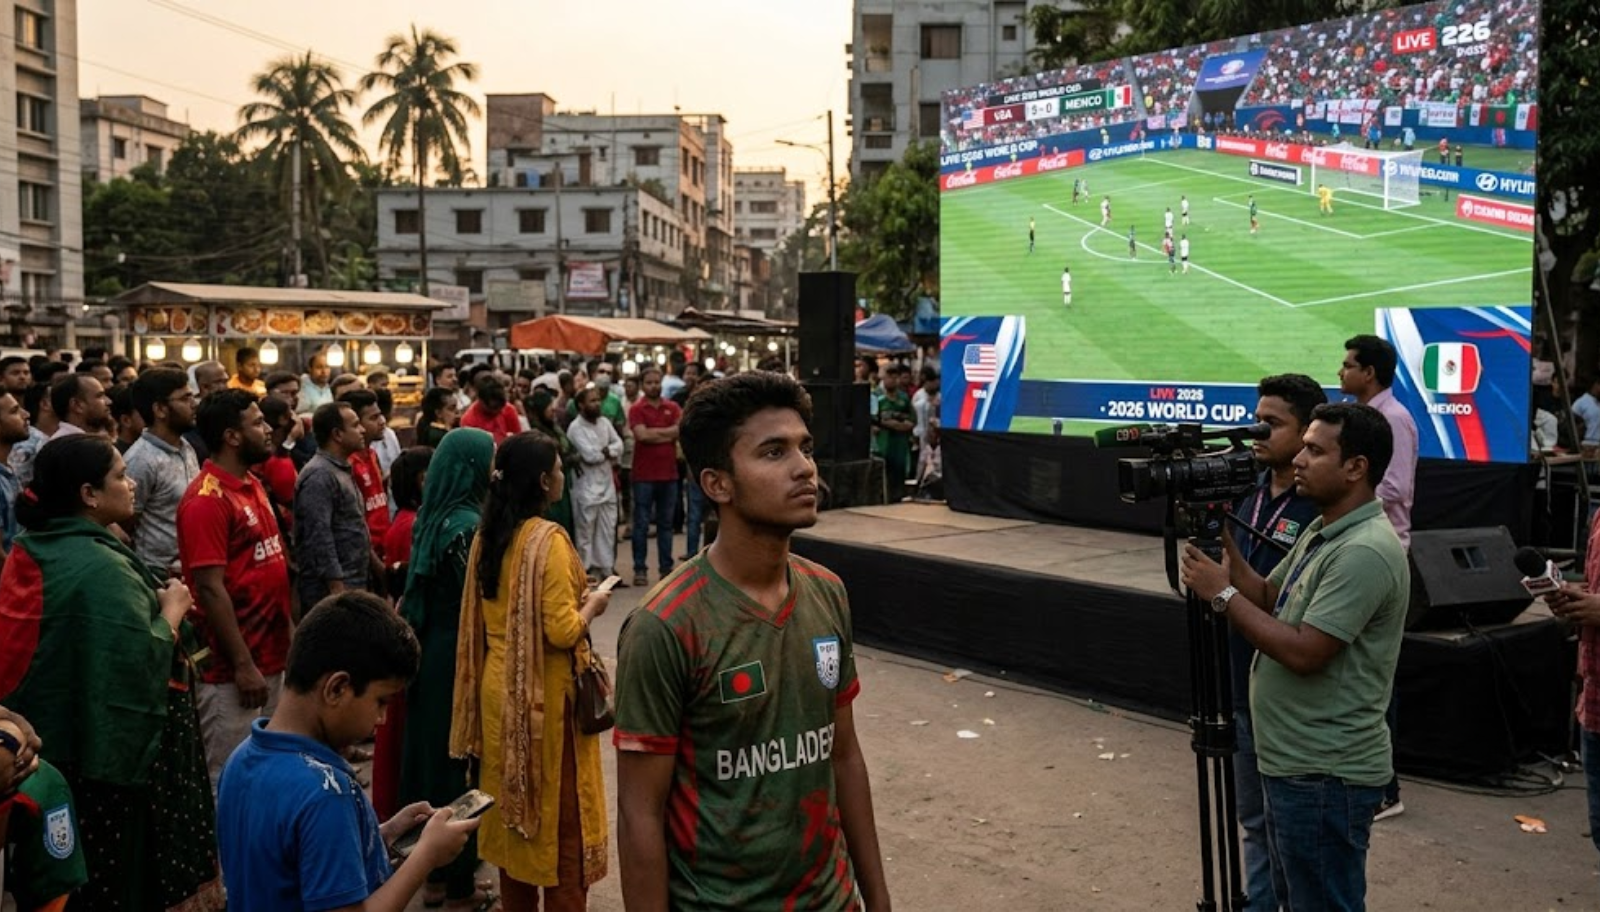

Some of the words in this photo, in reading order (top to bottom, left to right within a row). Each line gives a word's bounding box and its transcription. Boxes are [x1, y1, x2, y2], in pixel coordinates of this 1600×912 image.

[1397, 32, 1431, 50] LIVE
[1442, 21, 1491, 46] 226
[1108, 401, 1144, 418] 2026
[1147, 402, 1208, 420] WORLD
[1211, 404, 1245, 421] CUP
[1427, 404, 1472, 415] MEXICO
